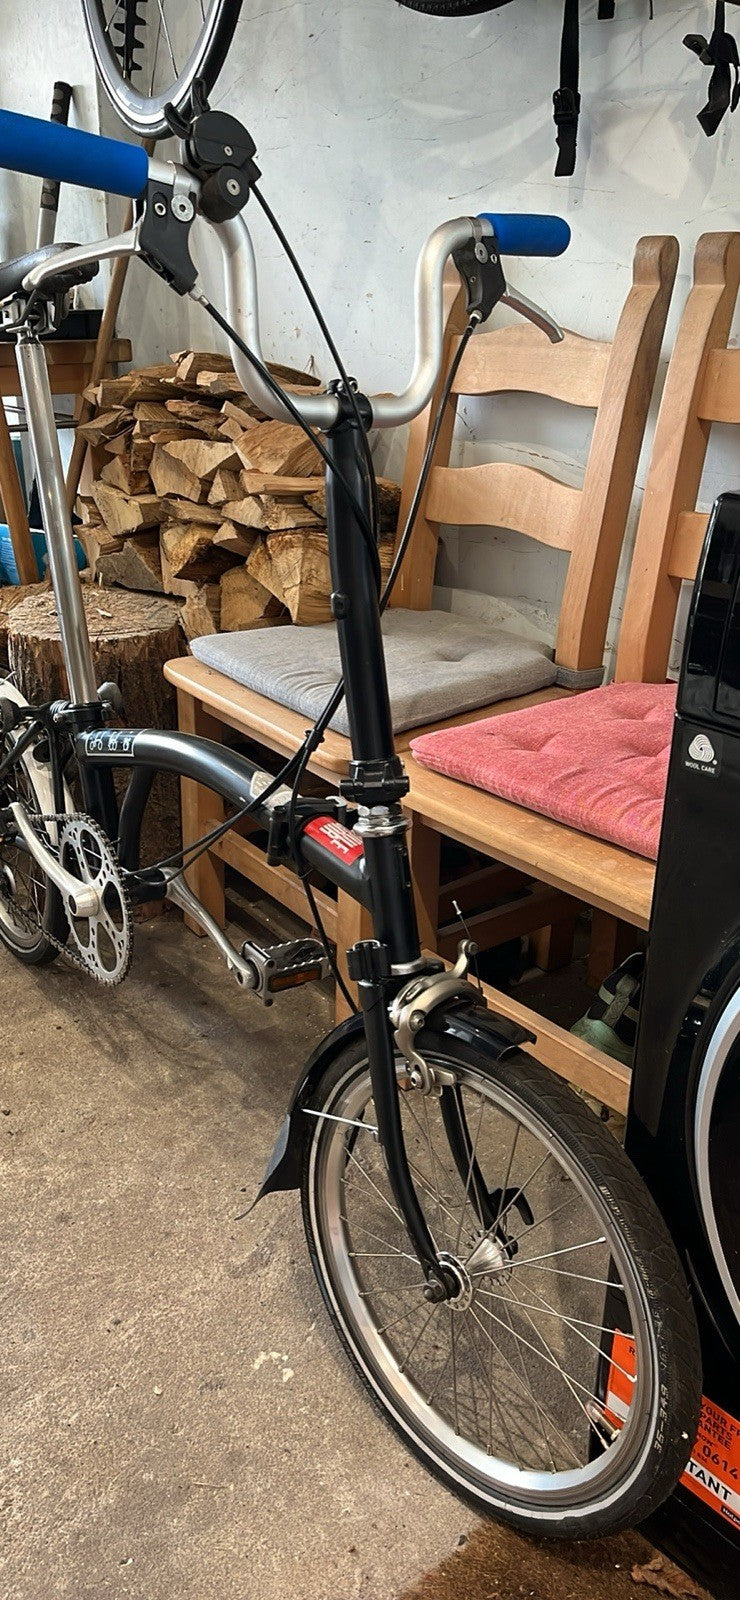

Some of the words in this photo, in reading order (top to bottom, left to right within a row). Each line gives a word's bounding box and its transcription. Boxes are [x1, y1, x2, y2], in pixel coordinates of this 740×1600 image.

[685, 761, 700, 770] WOOL
[701, 765, 716, 774] CARE
[700, 1411, 732, 1440] PARTS
